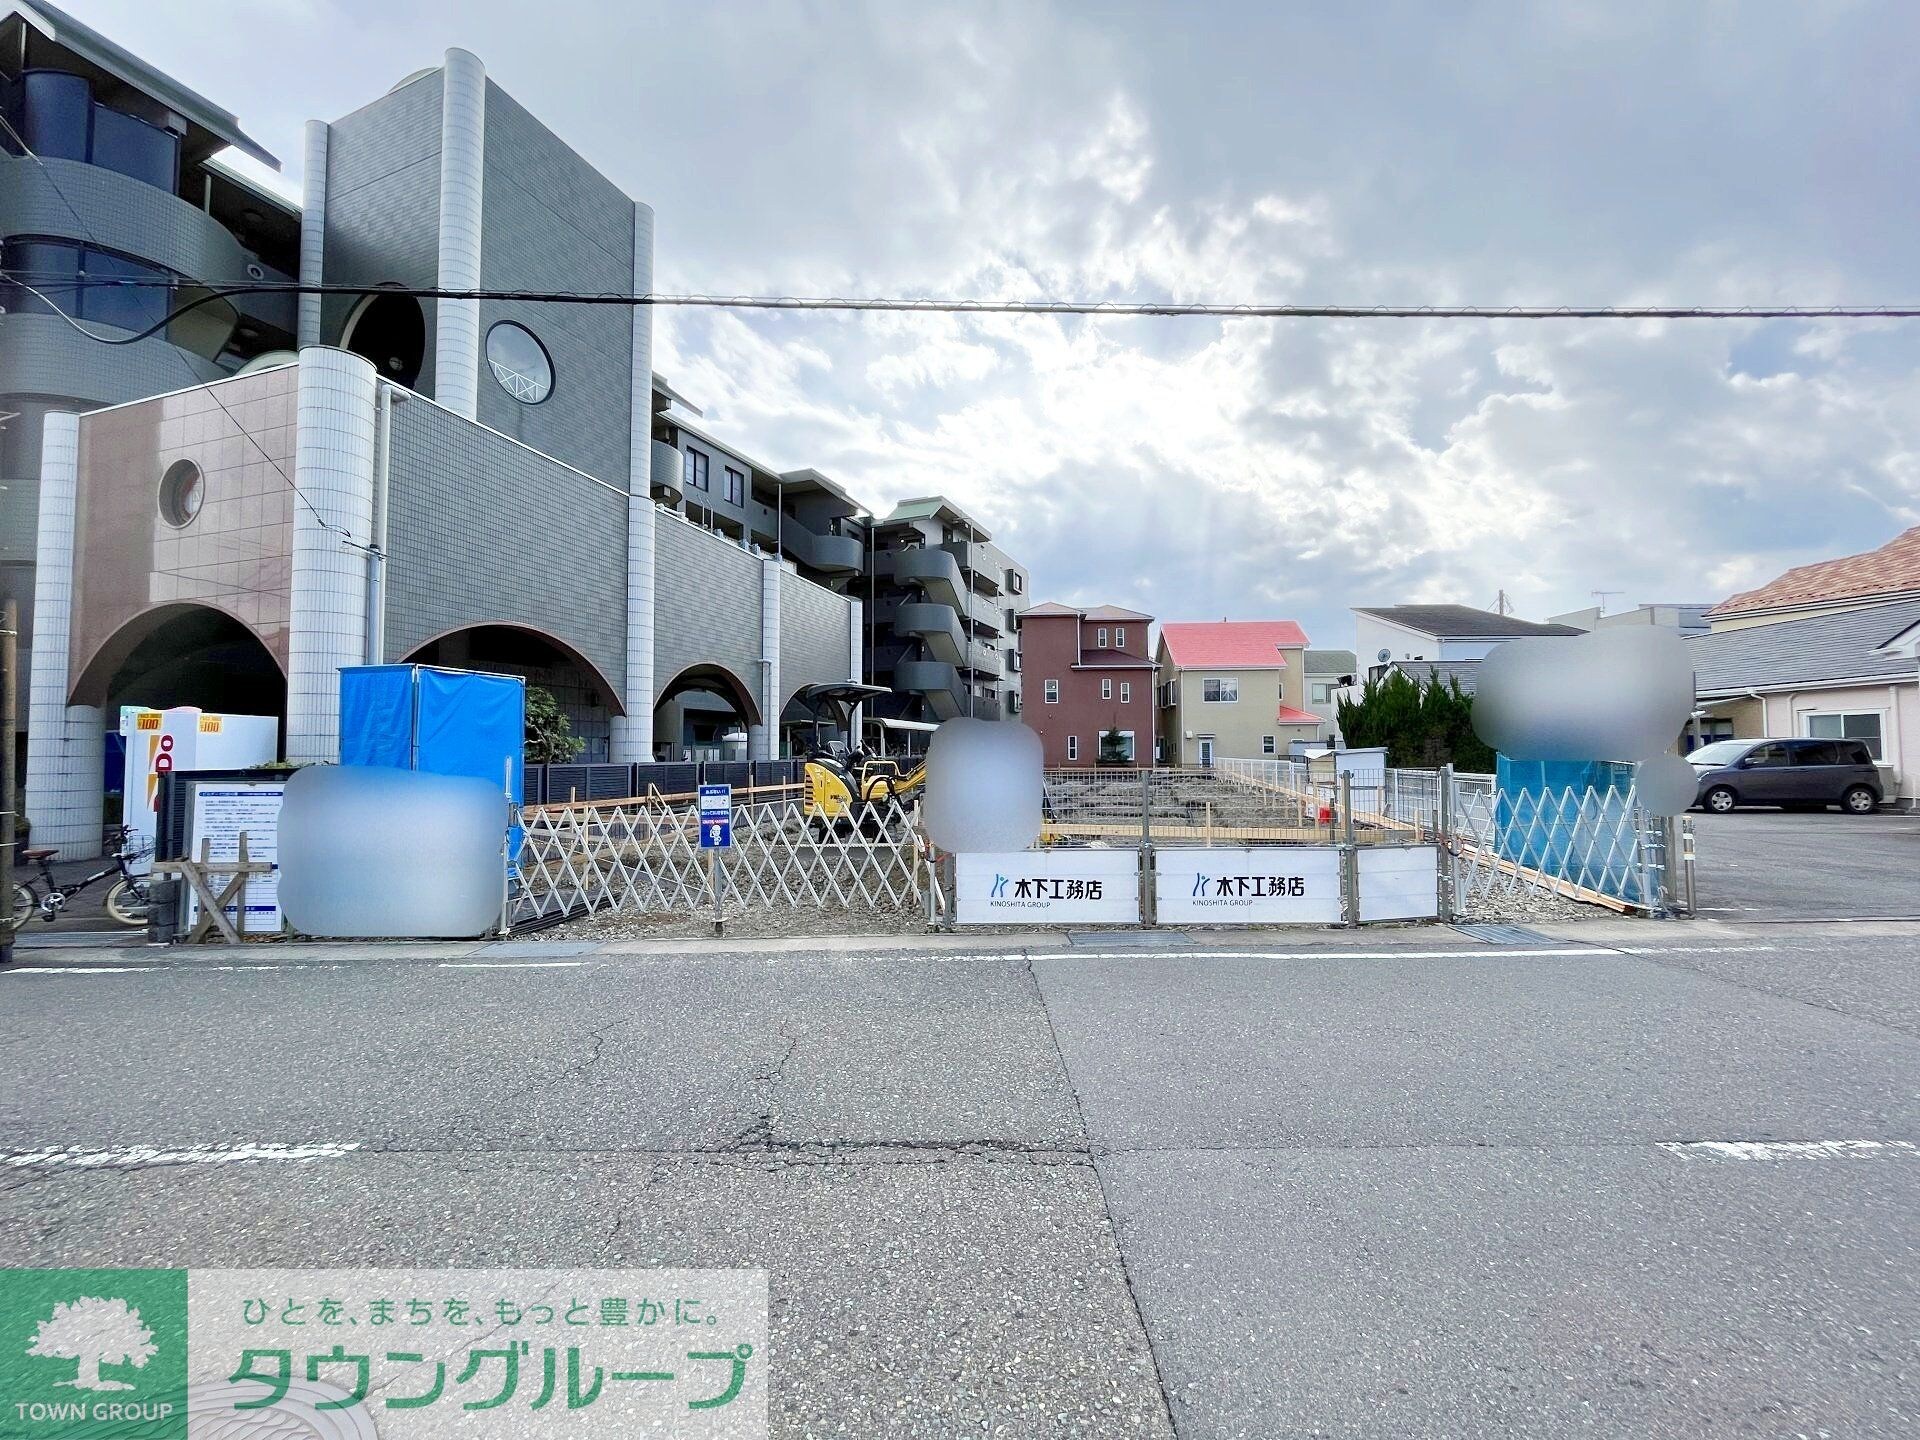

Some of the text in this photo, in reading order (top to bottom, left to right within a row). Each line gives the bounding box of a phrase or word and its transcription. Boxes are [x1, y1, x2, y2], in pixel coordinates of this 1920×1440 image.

[1014, 878, 1103, 900] 木下工務店
[1216, 876, 1305, 897] 木下工務店
[990, 900, 1051, 909] KINOSHITA GROUP
[1192, 899, 1253, 907] KINOSHITA GROUP
